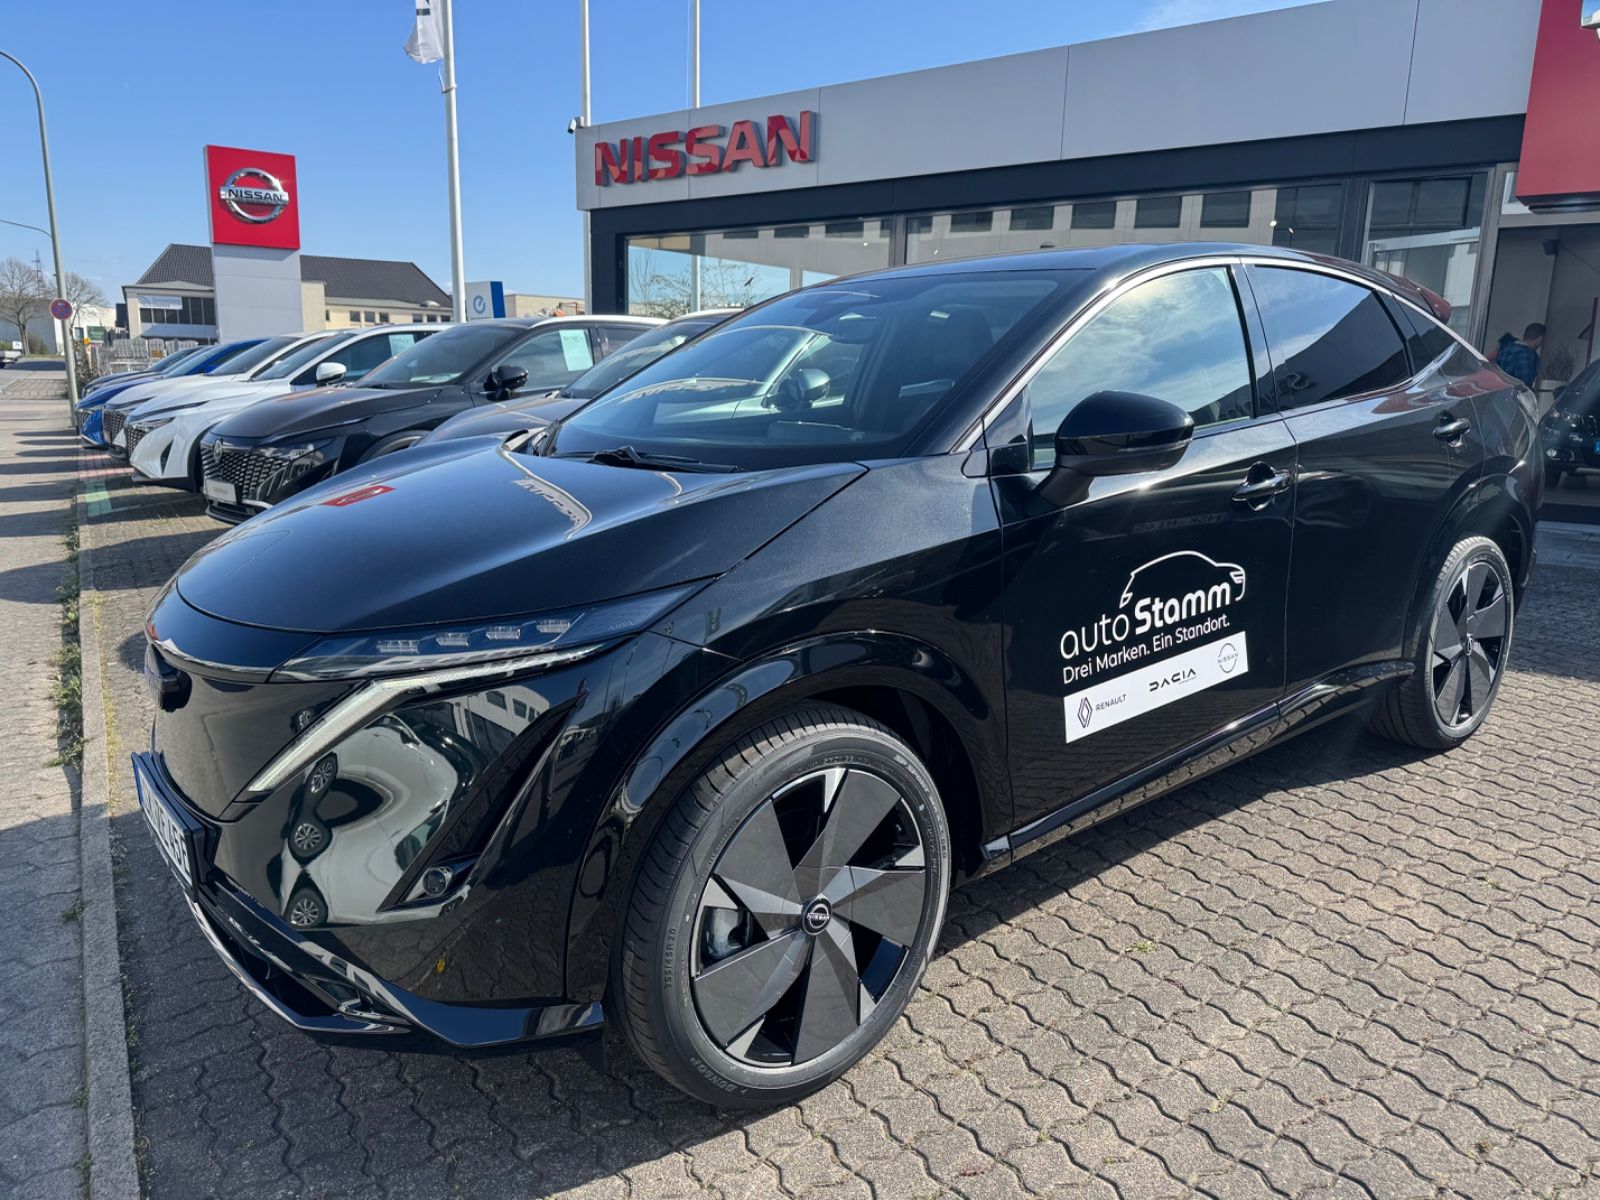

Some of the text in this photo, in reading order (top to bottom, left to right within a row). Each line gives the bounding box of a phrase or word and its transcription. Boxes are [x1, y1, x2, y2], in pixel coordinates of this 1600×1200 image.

[594, 110, 816, 187] NISSAN
[228, 188, 283, 202] NISSAN
[1060, 581, 1231, 660] auto Stamm
[1063, 613, 1230, 685] Drei Marken. Ein Standort.
[1095, 694, 1127, 712] RENAULT
[1149, 668, 1197, 692] DACIA
[664, 928, 677, 989] 255/45R20
